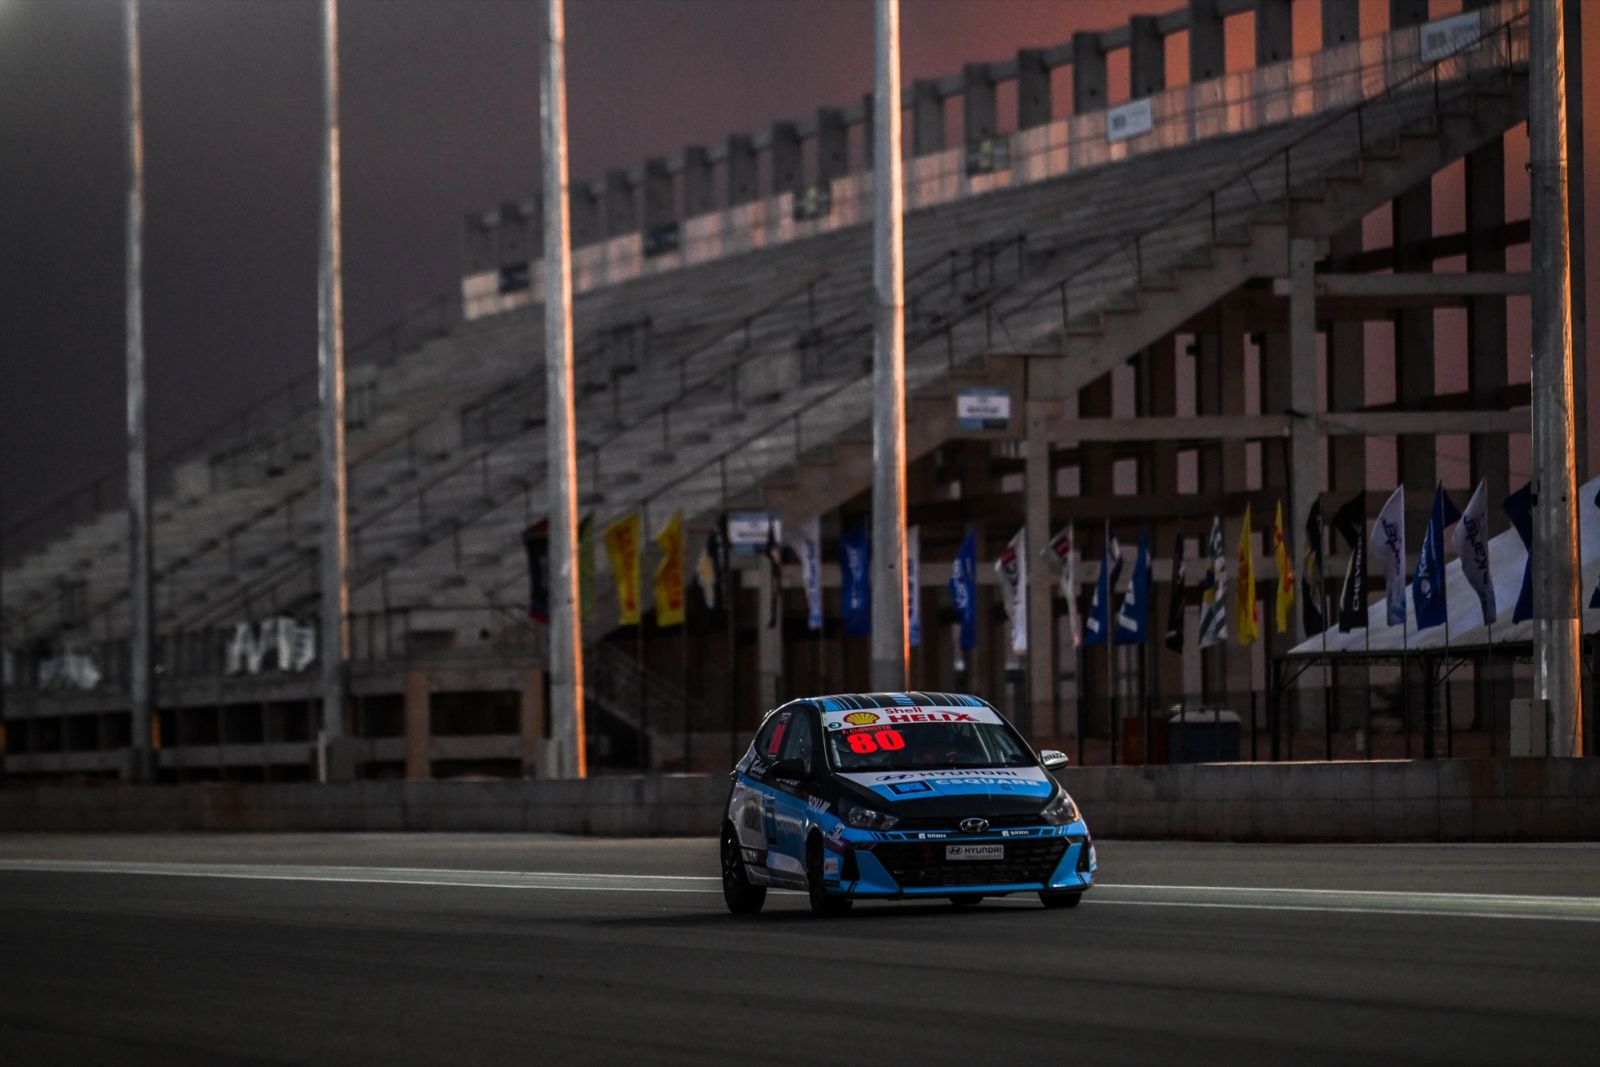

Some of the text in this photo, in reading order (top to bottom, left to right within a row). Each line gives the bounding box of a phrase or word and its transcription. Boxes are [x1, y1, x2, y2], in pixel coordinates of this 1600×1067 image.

[884, 707, 922, 715] Shell
[888, 713, 976, 723] HELIX
[846, 729, 907, 755] 80
[918, 771, 1017, 779] HYUNDAI
[964, 846, 1002, 854] HYUNDAI
